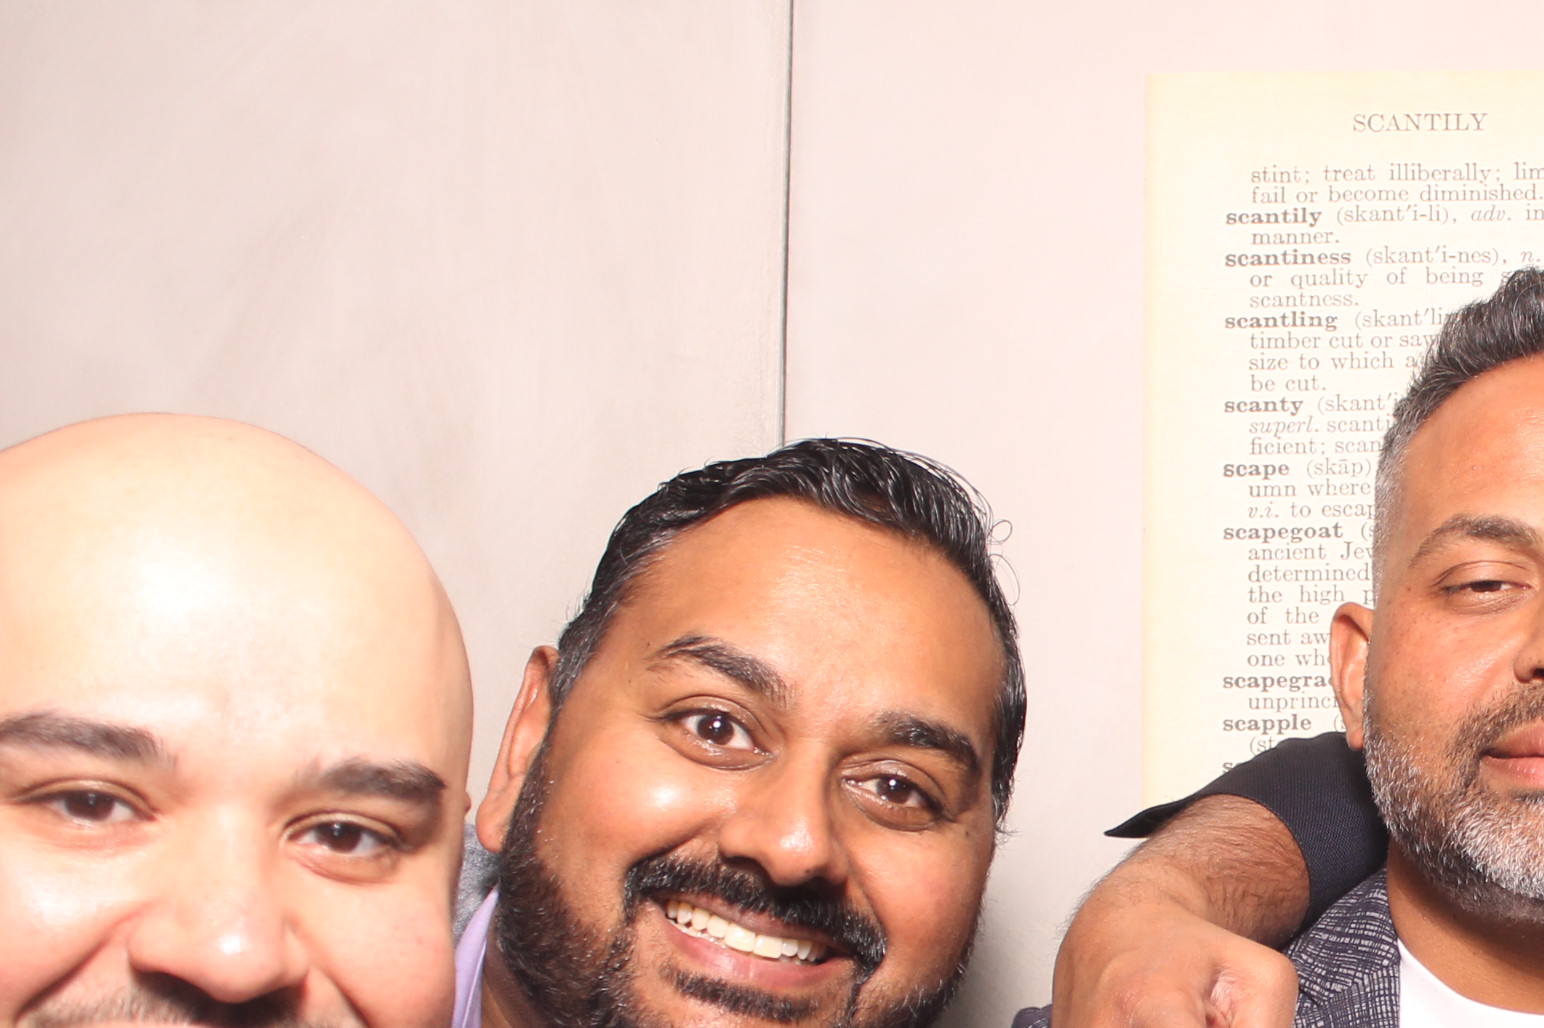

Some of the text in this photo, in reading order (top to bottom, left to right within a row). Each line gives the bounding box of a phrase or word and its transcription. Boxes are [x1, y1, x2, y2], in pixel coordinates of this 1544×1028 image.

[1352, 112, 1488, 132] SCANTILY
[1251, 164, 1310, 185] stint;
[1323, 164, 1376, 181] treat
[1389, 161, 1501, 184] illiberally;
[1251, 183, 1544, 204] fail or become diminished.
[1225, 207, 1322, 228] scantily
[1470, 204, 1512, 222] adv.
[1250, 231, 1340, 245] manner.
[1224, 248, 1352, 267] scantiness
[1520, 251, 1541, 263] n.
[1249, 274, 1272, 288] or
[1290, 267, 1368, 290] quality
[1386, 266, 1408, 285] of
[1426, 265, 1484, 287] being
[1249, 291, 1359, 308] scantness.
[1224, 310, 1338, 331] scantling
[1249, 331, 1321, 349] timber
[1328, 332, 1364, 349] cut
[1370, 334, 1393, 348] or
[1248, 352, 1289, 370] size
[1299, 353, 1320, 370] to
[1330, 350, 1395, 369] which
[1250, 374, 1327, 392] be cut.
[1223, 396, 1304, 417] scanty
[1248, 415, 1320, 439] superl.
[1249, 437, 1326, 456] ficient;
[1223, 463, 1290, 480] scape
[1248, 478, 1371, 498] umn where
[1248, 501, 1279, 518] v.i.
[1290, 502, 1312, 518] to
[1223, 522, 1344, 543] scapegoat
[1248, 542, 1327, 560] ancient
[1247, 563, 1372, 582] determined
[1247, 585, 1283, 603] the
[1299, 584, 1345, 605] high
[1246, 606, 1319, 625] of the
[1246, 629, 1291, 646] sent
[1246, 648, 1331, 667] one wh
[1222, 714, 1312, 735] scapple
